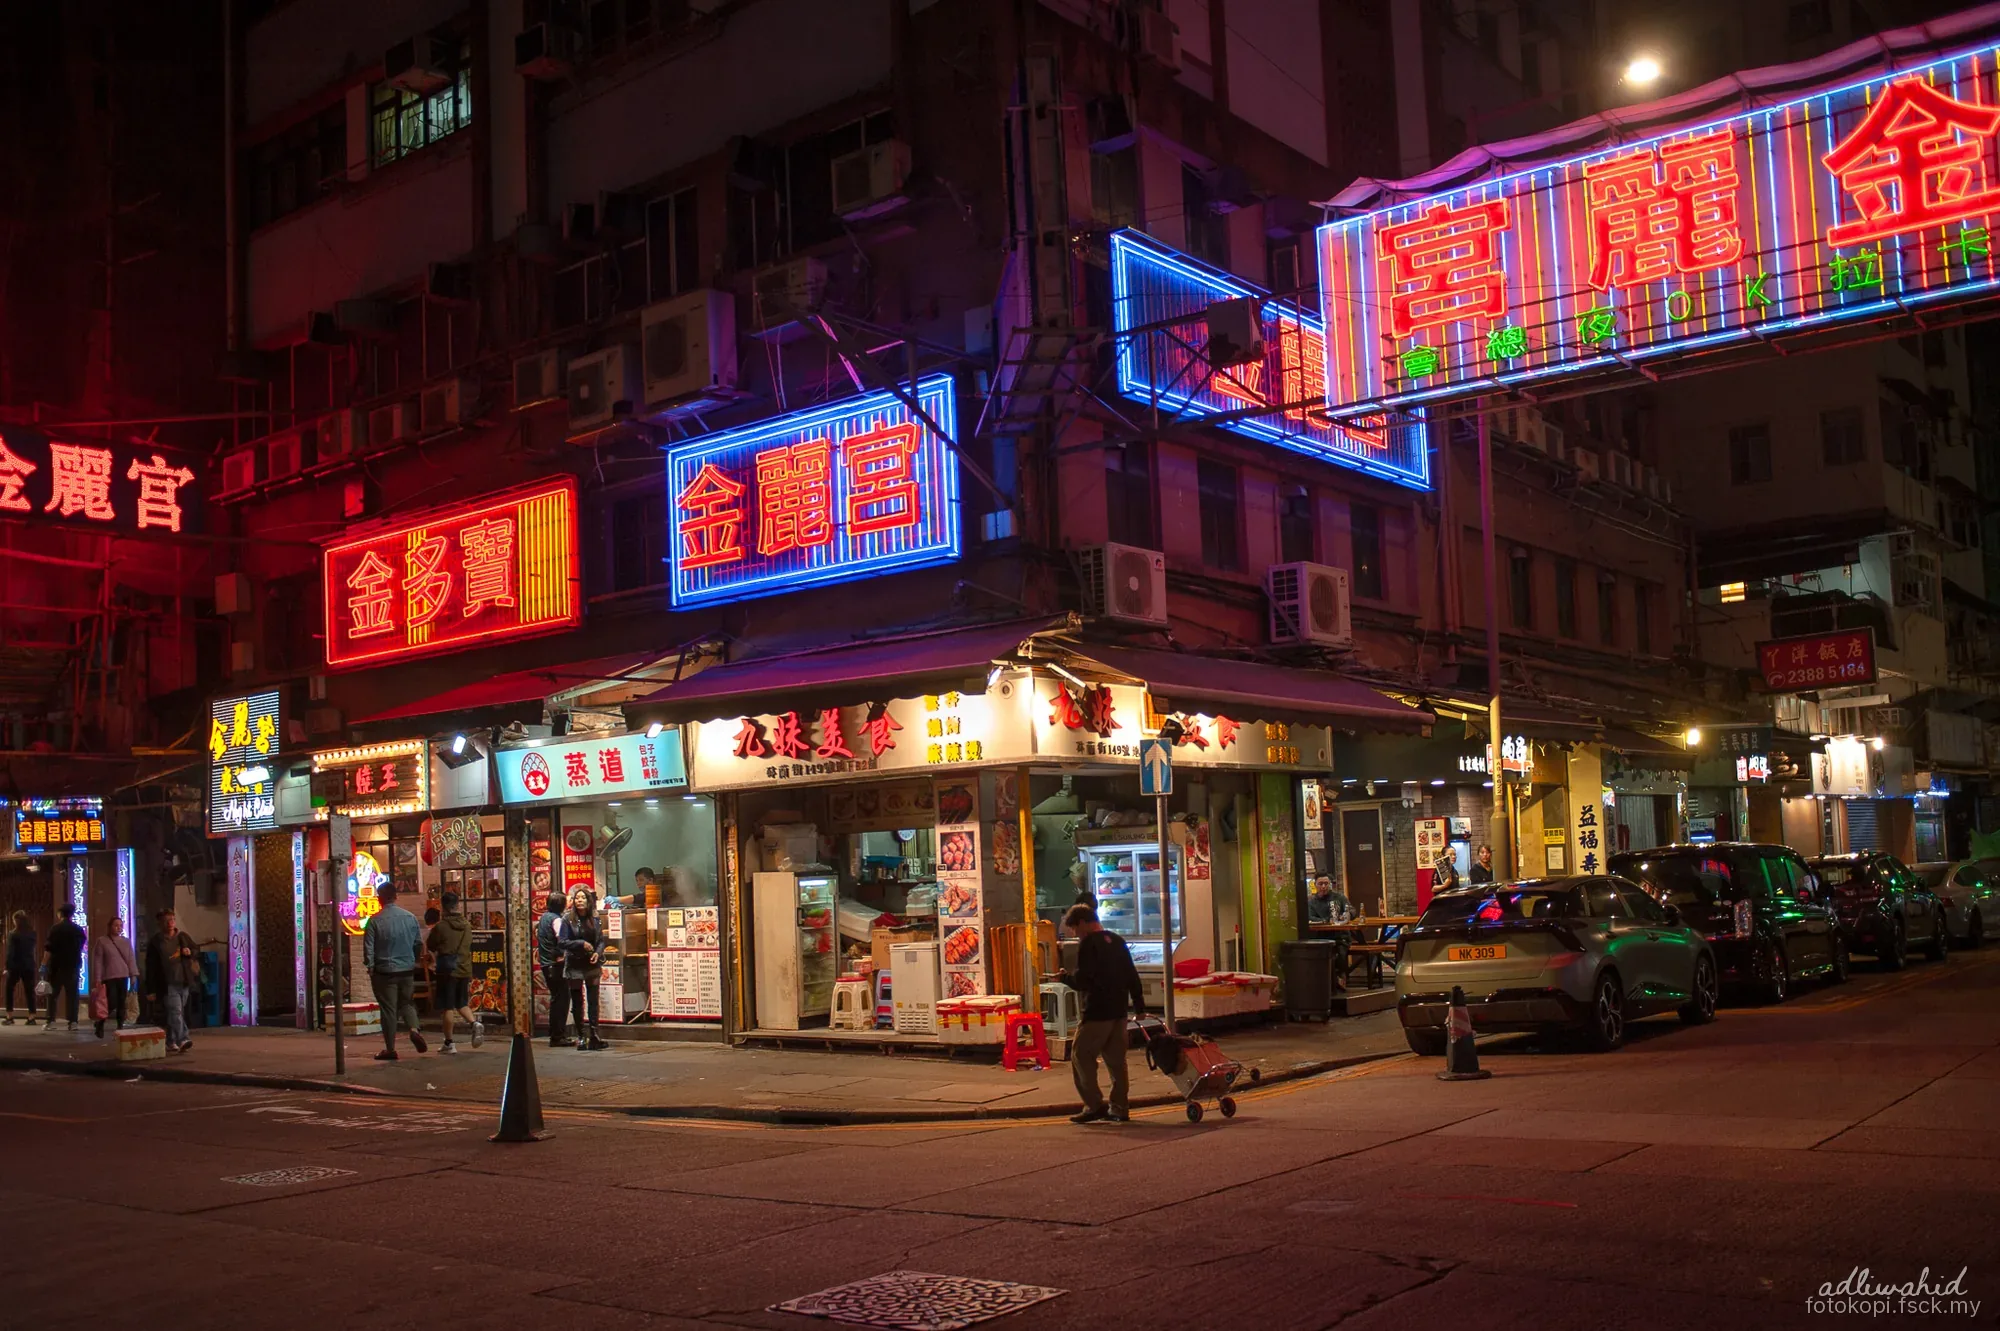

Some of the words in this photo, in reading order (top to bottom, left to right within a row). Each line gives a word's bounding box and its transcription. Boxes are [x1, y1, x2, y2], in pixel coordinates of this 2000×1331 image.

[676, 420, 921, 570] 金麗宮
[347, 518, 514, 639] 金多寶
[1788, 667, 1825, 684] 2388
[1828, 661, 1867, 679] 5184
[639, 744, 655, 755] 包子
[732, 707, 904, 760] 九妹美食
[562, 747, 624, 788] 蒸道
[18, 820, 102, 843] 金麗宮夜總會
[1459, 949, 1473, 959] NK
[1475, 947, 1495, 958] 309
